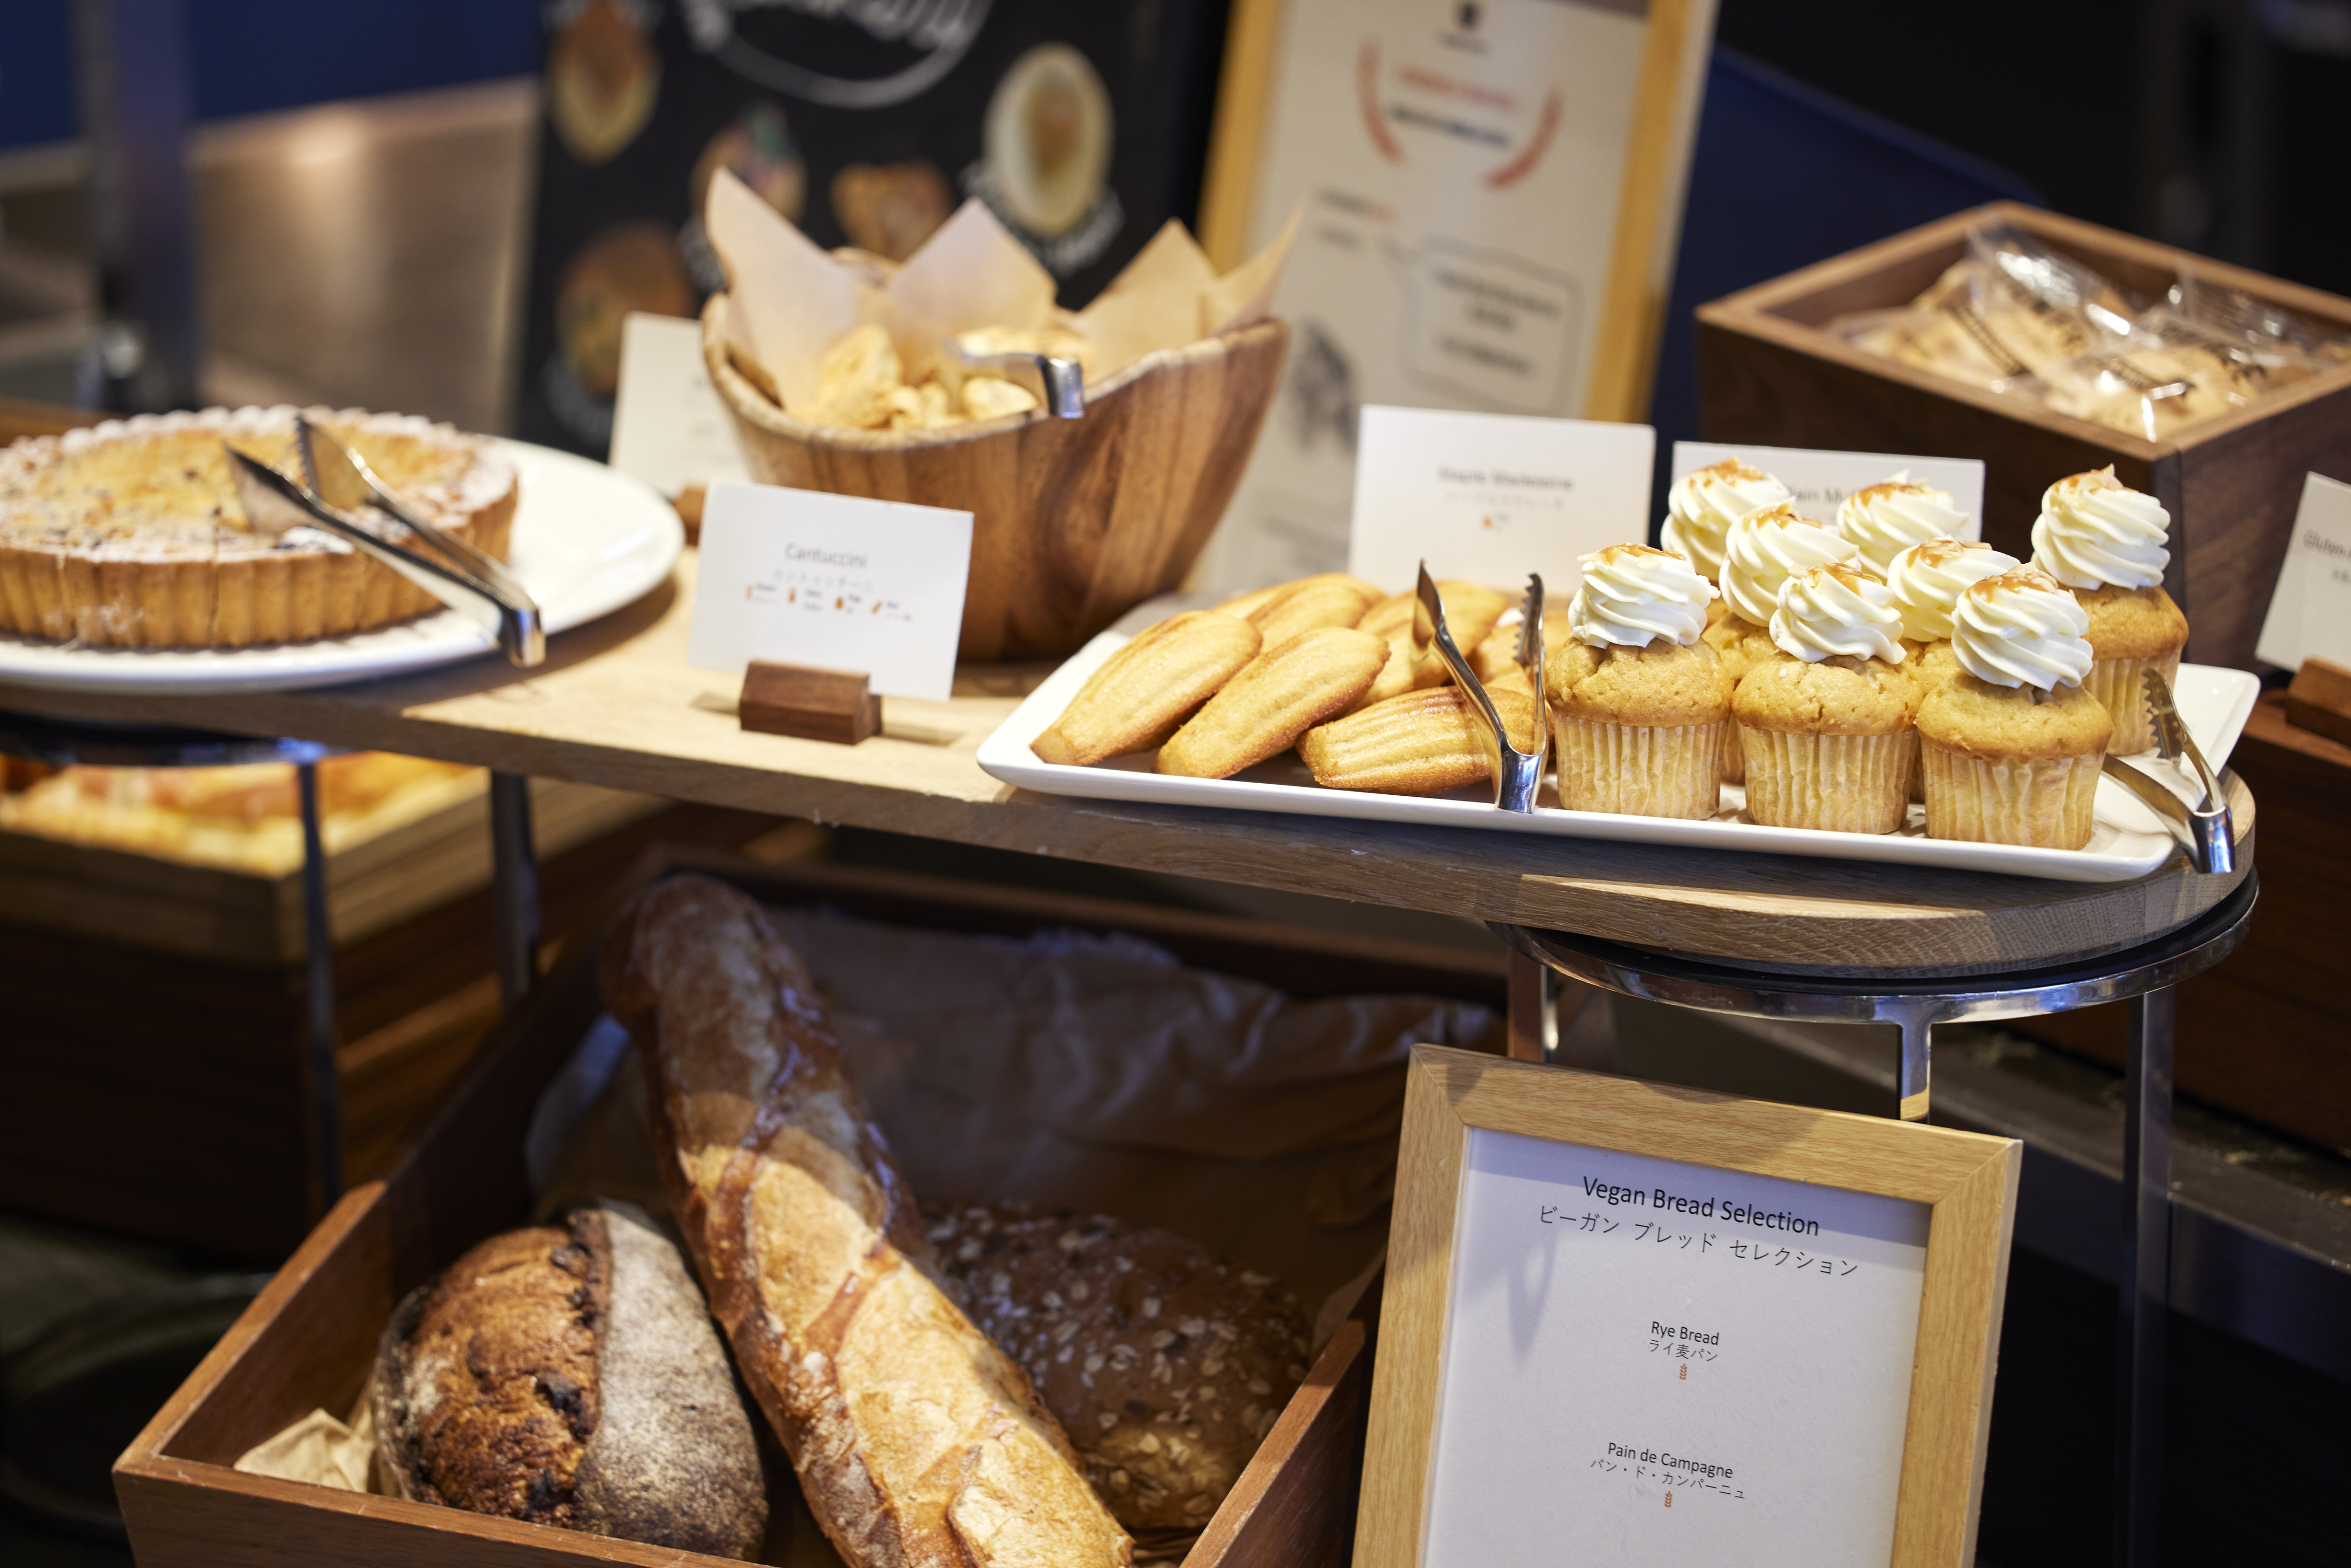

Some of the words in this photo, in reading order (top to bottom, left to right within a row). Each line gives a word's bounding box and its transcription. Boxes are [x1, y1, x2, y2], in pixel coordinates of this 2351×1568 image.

[784, 542, 867, 568] Cantuccini
[1583, 1176, 1645, 1205] Vegan
[1653, 1188, 1715, 1218] Bread
[1720, 1201, 1819, 1236] Selection
[1540, 1205, 1620, 1234] ビーガン
[1634, 1222, 1716, 1253] ブレッド
[1729, 1239, 1858, 1276] セレクション
[1649, 1339, 1718, 1362] ライ麦パン
[1651, 1321, 1675, 1338] Rye
[1680, 1326, 1720, 1346] Bread
[1590, 1459, 1745, 1499] パン・ド・カンパーニュ
[1608, 1442, 1636, 1459] Pain
[1640, 1448, 1657, 1464] de
[1661, 1453, 1733, 1479] Campagne
